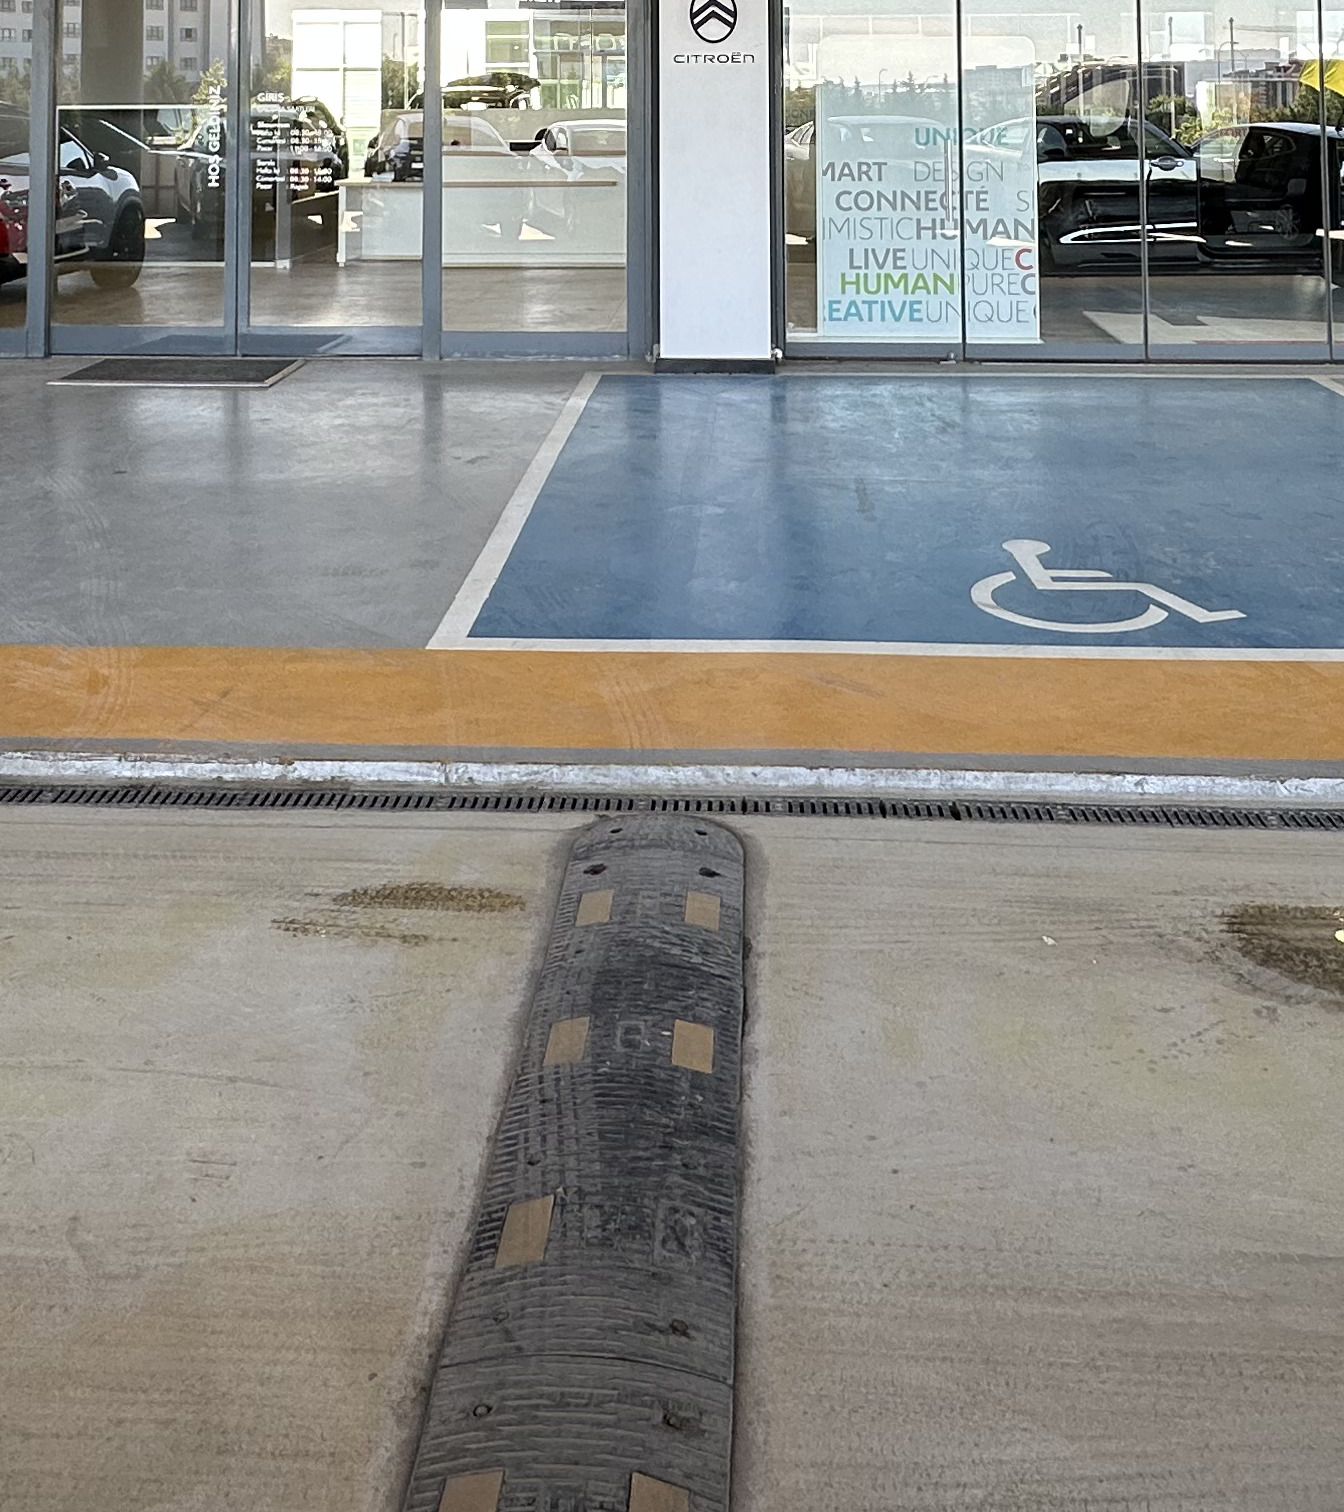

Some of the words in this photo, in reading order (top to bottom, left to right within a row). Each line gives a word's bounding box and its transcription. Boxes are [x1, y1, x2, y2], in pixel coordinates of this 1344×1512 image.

[673, 51, 755, 64] CITROËN
[849, 248, 906, 270] LIVE
[841, 273, 954, 295] HUMAN
[824, 300, 924, 322] EATIVE
